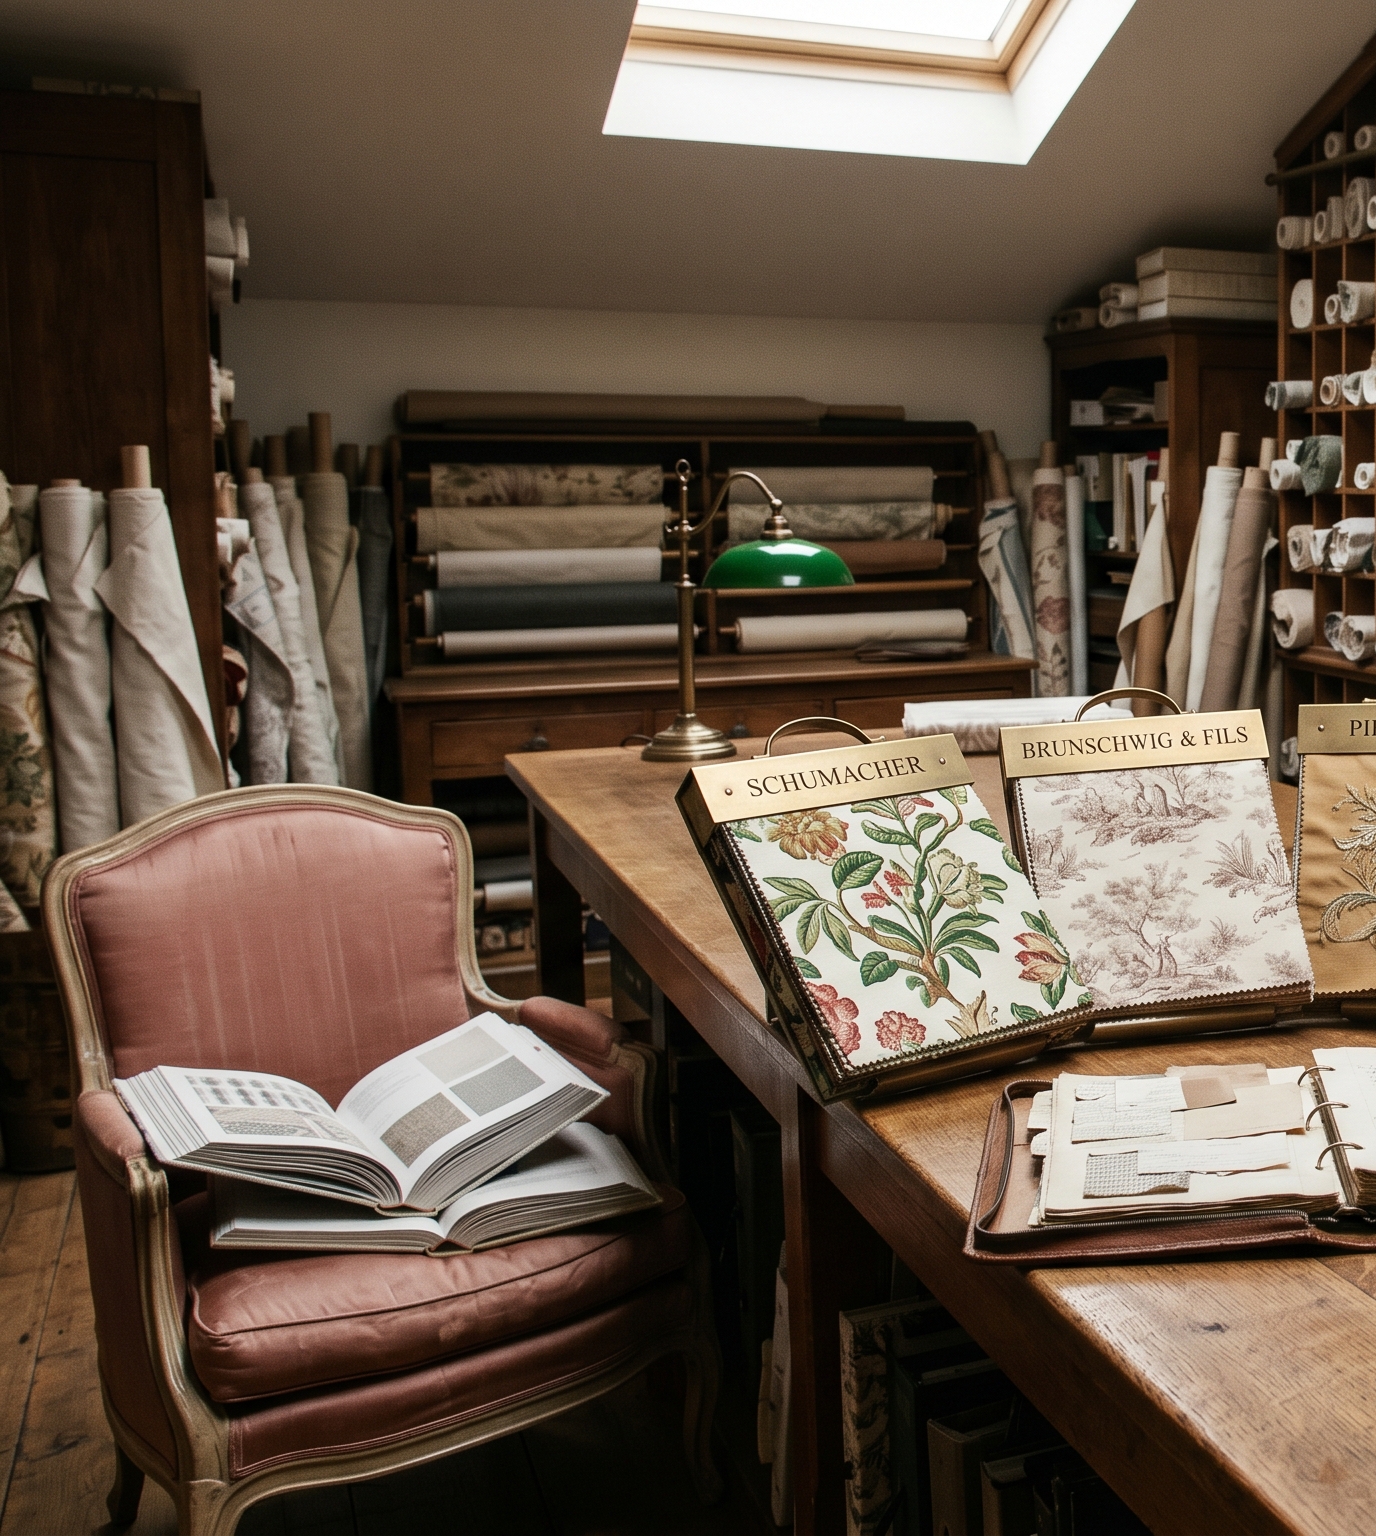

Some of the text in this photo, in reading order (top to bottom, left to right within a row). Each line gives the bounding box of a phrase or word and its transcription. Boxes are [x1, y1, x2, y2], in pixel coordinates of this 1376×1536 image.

[1022, 726, 1249, 760] BRUNSCHWIG & FILS
[746, 755, 926, 798] SCHUMACHER
